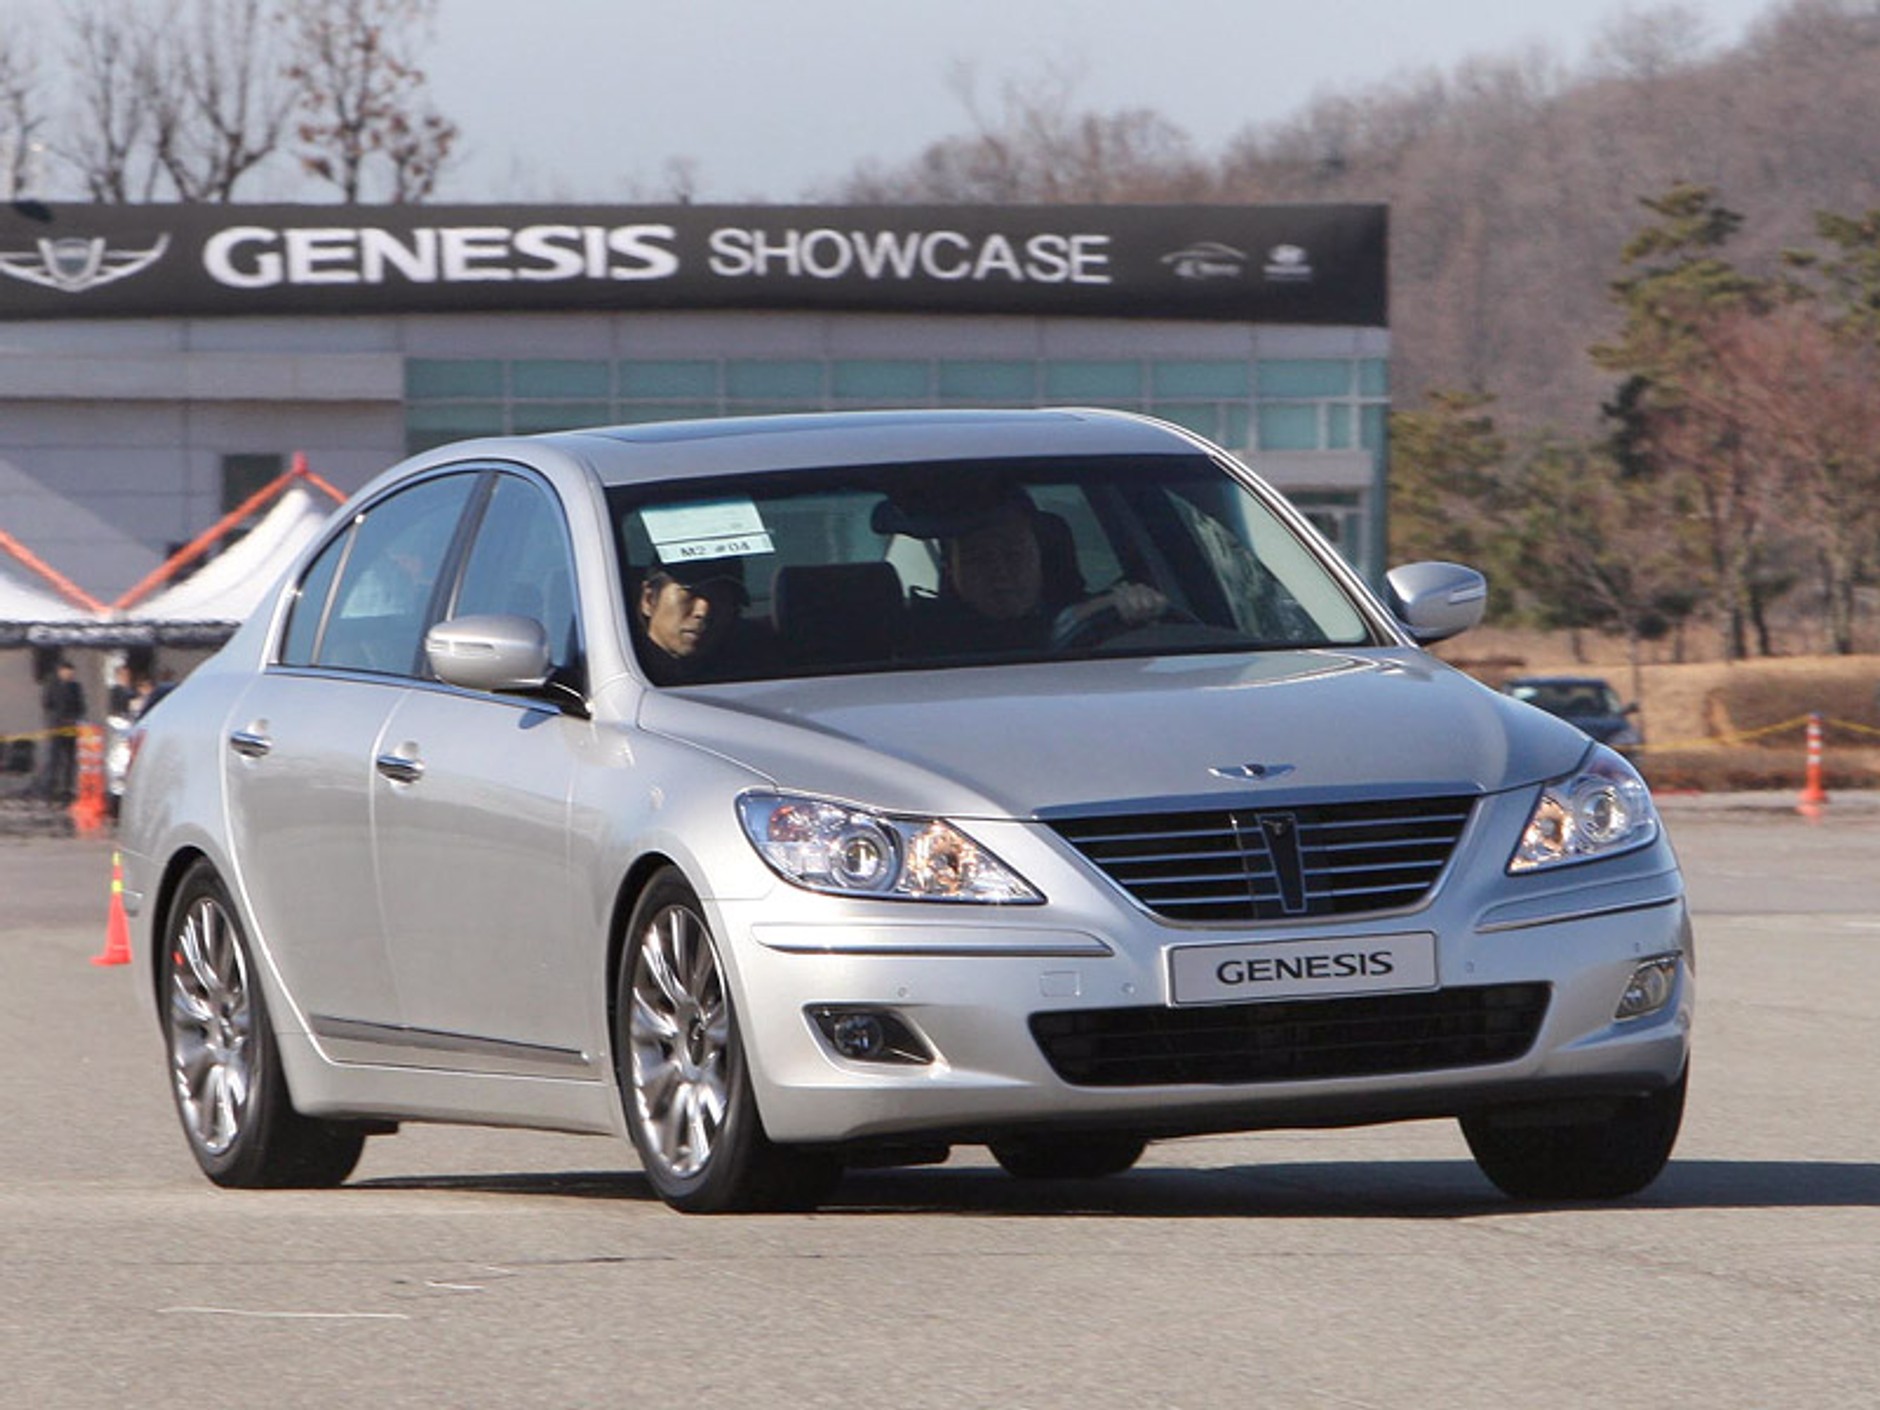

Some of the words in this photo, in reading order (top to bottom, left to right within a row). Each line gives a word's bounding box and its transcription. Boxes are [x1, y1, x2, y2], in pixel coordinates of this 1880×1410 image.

[203, 224, 679, 288] GENESIS
[708, 228, 1112, 284] SHOWCASE
[1216, 951, 1394, 985] GENESIS
